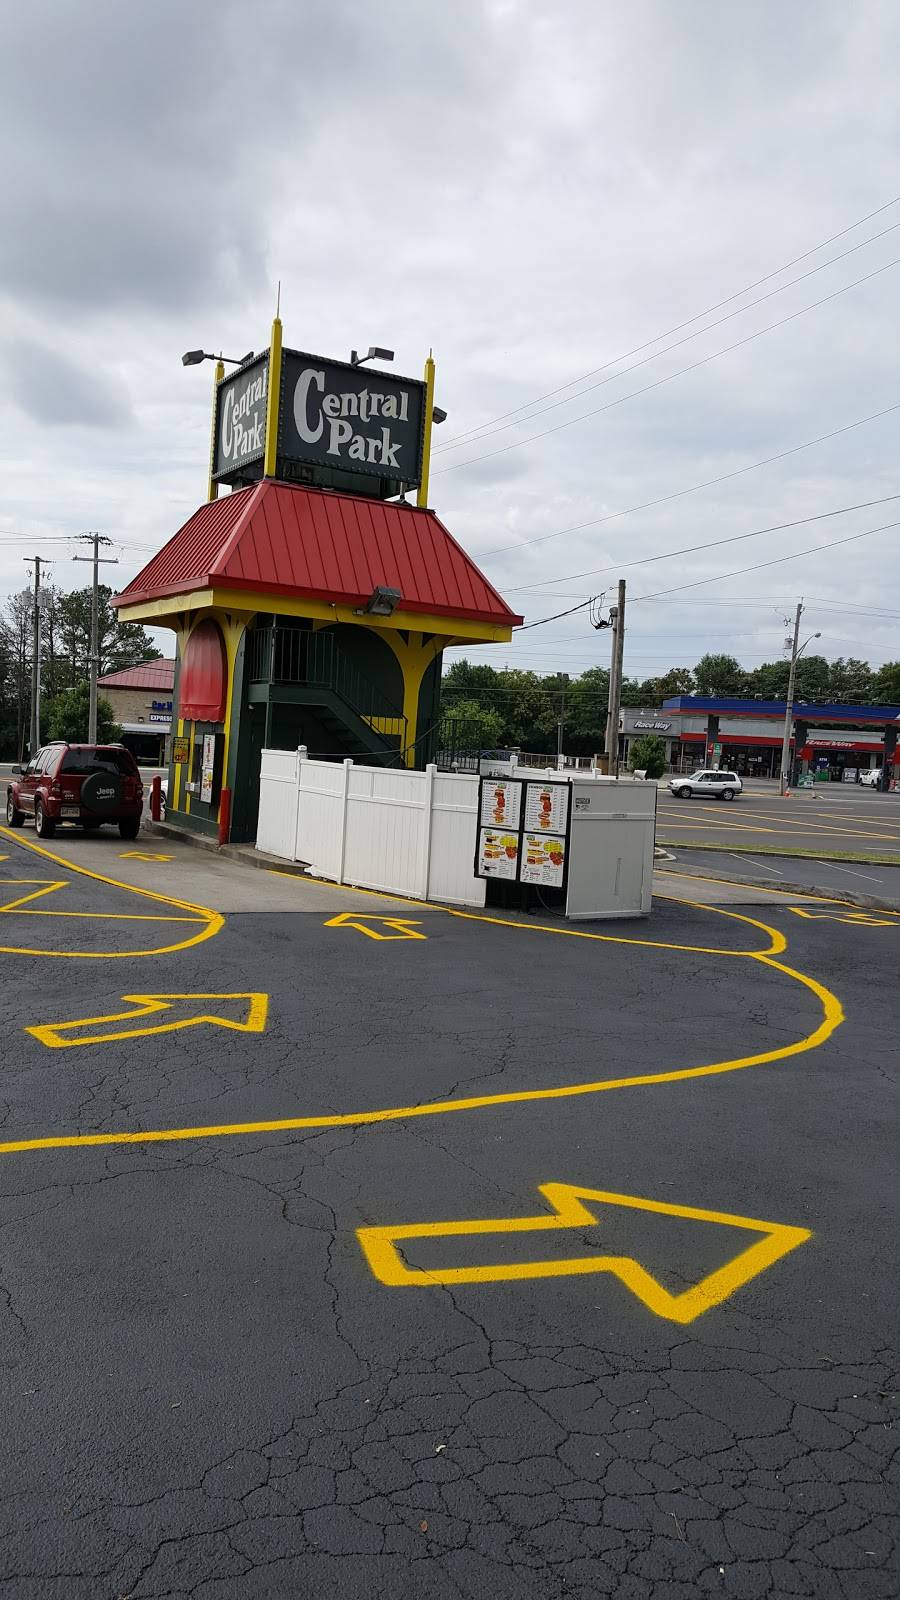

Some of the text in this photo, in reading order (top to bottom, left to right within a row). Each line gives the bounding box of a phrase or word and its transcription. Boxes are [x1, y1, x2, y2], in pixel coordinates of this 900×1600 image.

[222, 367, 268, 459] Central
[293, 368, 409, 444] Central
[232, 409, 263, 460] Park
[326, 416, 403, 469] Park
[96, 787, 115, 796] Jeep
